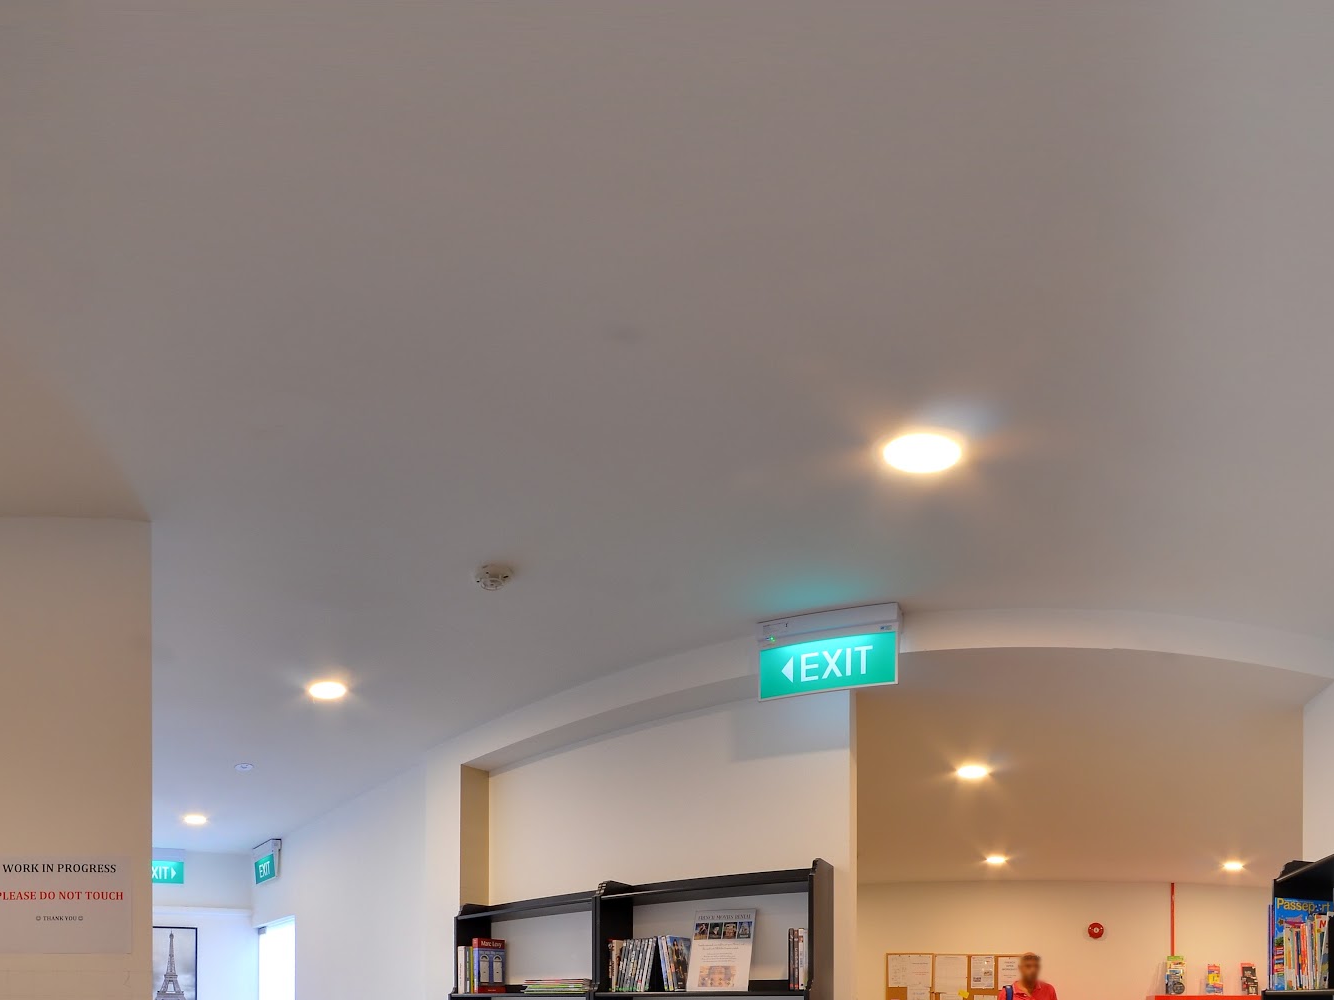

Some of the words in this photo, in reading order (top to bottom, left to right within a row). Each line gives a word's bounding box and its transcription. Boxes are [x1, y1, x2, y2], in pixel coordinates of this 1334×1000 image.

[800, 645, 873, 682] EXIT
[2, 864, 39, 873] WORK
[42, 864, 54, 873] IN
[57, 864, 117, 874] PROGRESS
[258, 860, 271, 878] EXIT
[39, 892, 56, 900] DO
[58, 892, 82, 900] NOT
[85, 892, 124, 900] TOUCH
